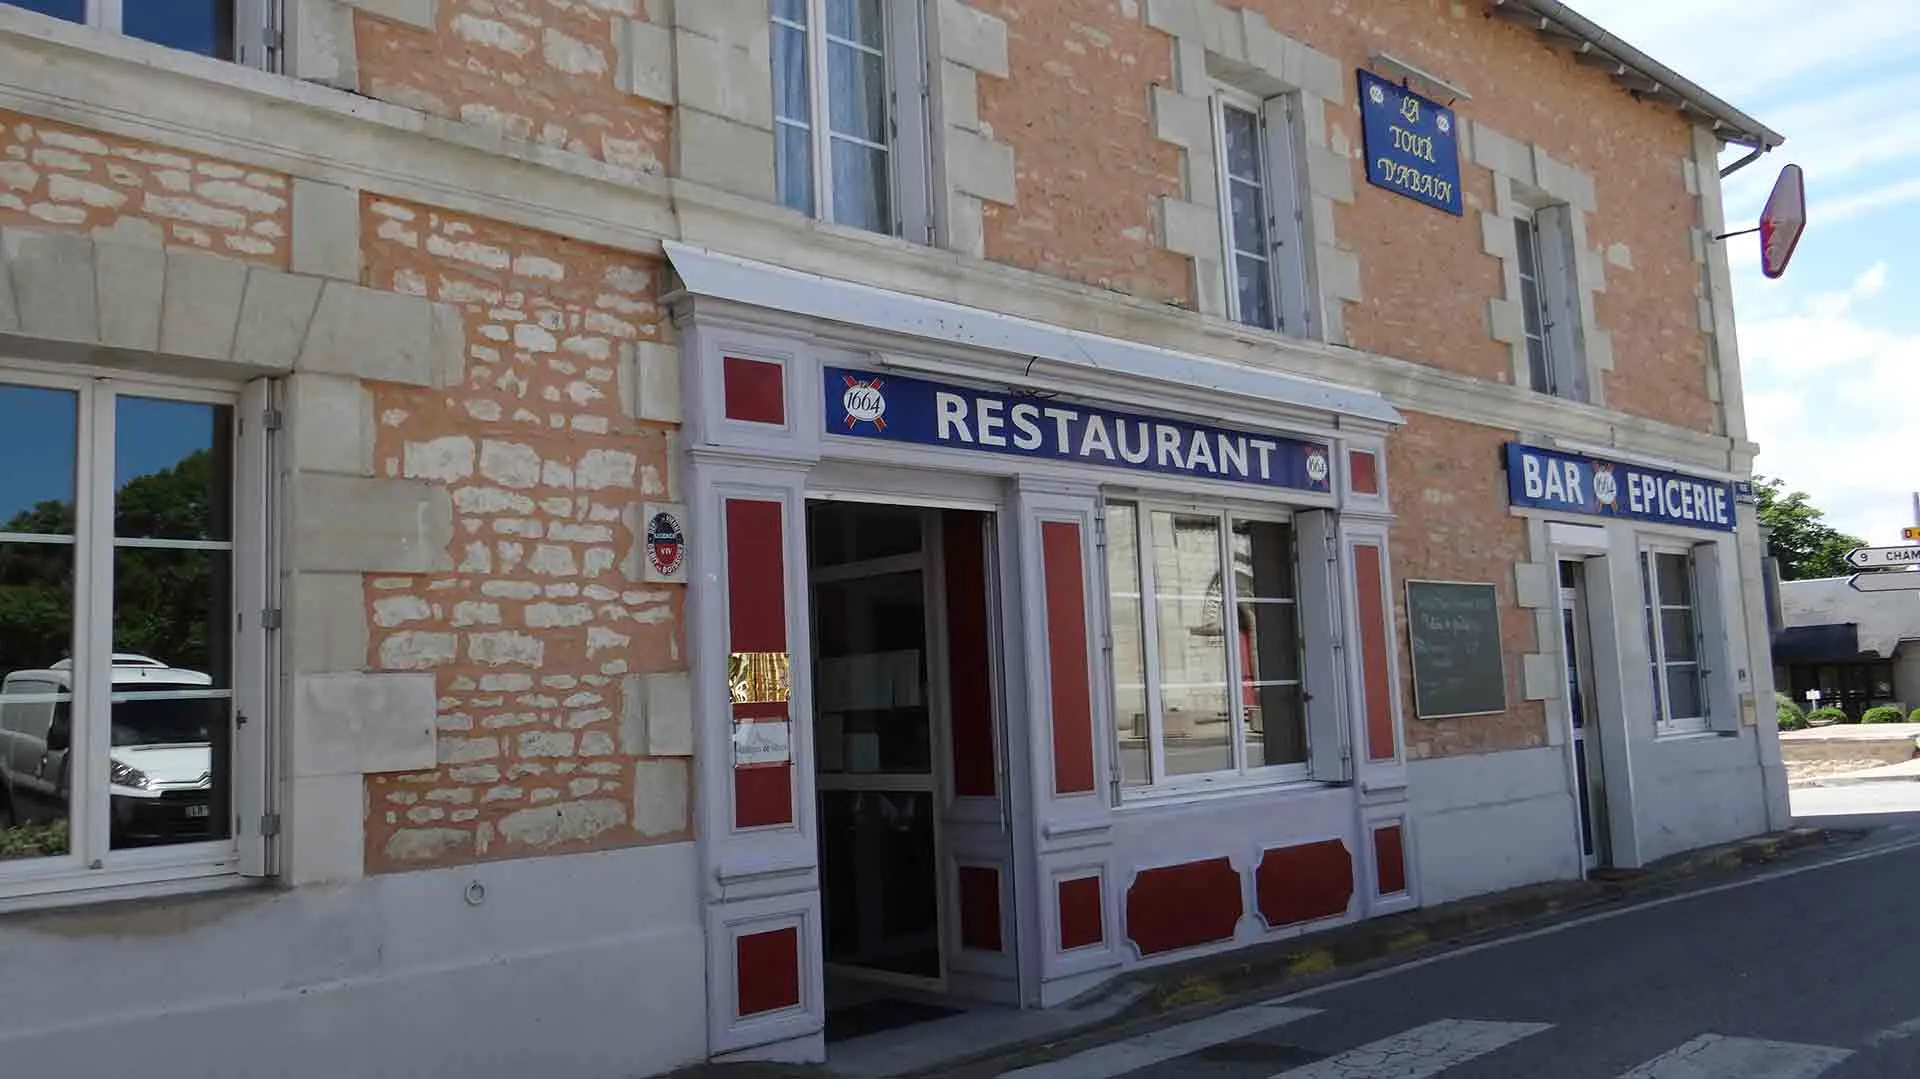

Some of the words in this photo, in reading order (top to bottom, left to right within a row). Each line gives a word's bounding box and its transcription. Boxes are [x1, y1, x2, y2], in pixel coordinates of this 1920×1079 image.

[1400, 96, 1420, 123] LA
[1389, 125, 1435, 163] TOUR
[1377, 158, 1452, 203] D'ABAIN
[847, 390, 881, 413] 1664
[936, 391, 1277, 480] RESTAURANT
[1522, 454, 1584, 505] BAR
[1627, 471, 1728, 524] EPICERIE
[1860, 553, 1868, 562] 9
